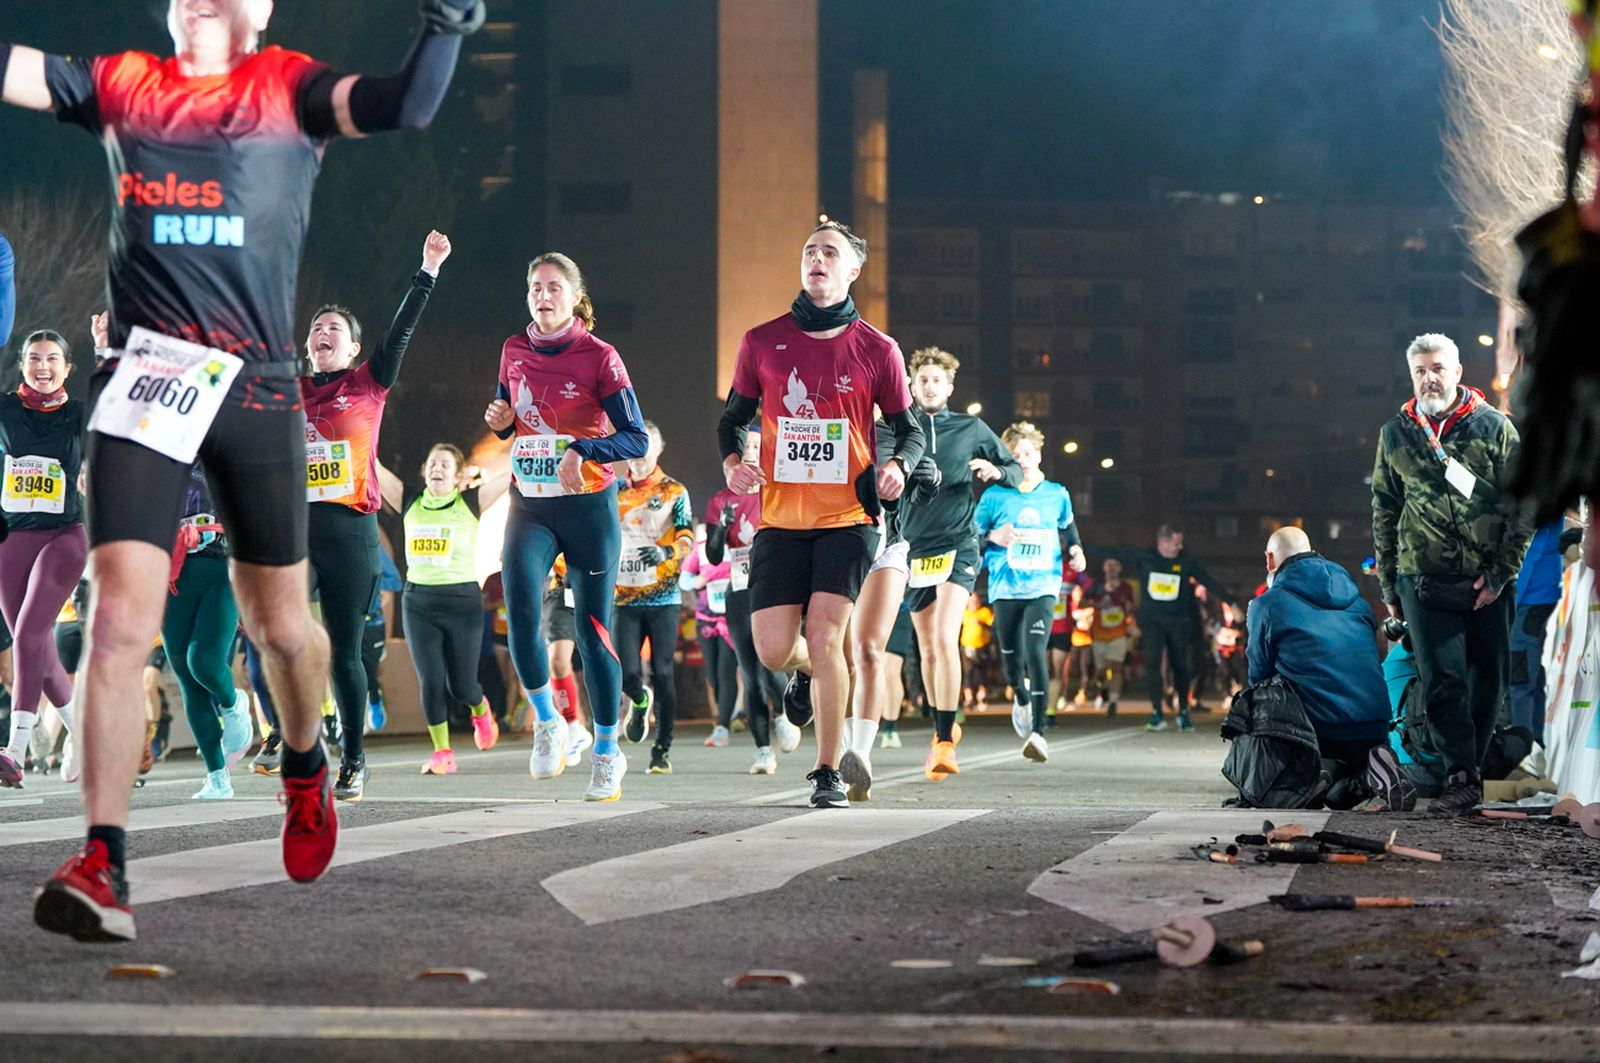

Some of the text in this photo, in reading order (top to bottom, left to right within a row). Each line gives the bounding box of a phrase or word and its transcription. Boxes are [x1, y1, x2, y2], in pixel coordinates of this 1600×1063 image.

[152, 213, 244, 247] RUN
[128, 374, 199, 415] 6060
[523, 409, 541, 429] 43
[783, 432, 796, 440] SAN
[796, 433, 821, 441] ANTON
[790, 425, 821, 434] NOCHE DE
[787, 441, 835, 462] 3429
[15, 475, 54, 494] 3949
[413, 538, 447, 552] 13357
[1020, 543, 1041, 555] 7771
